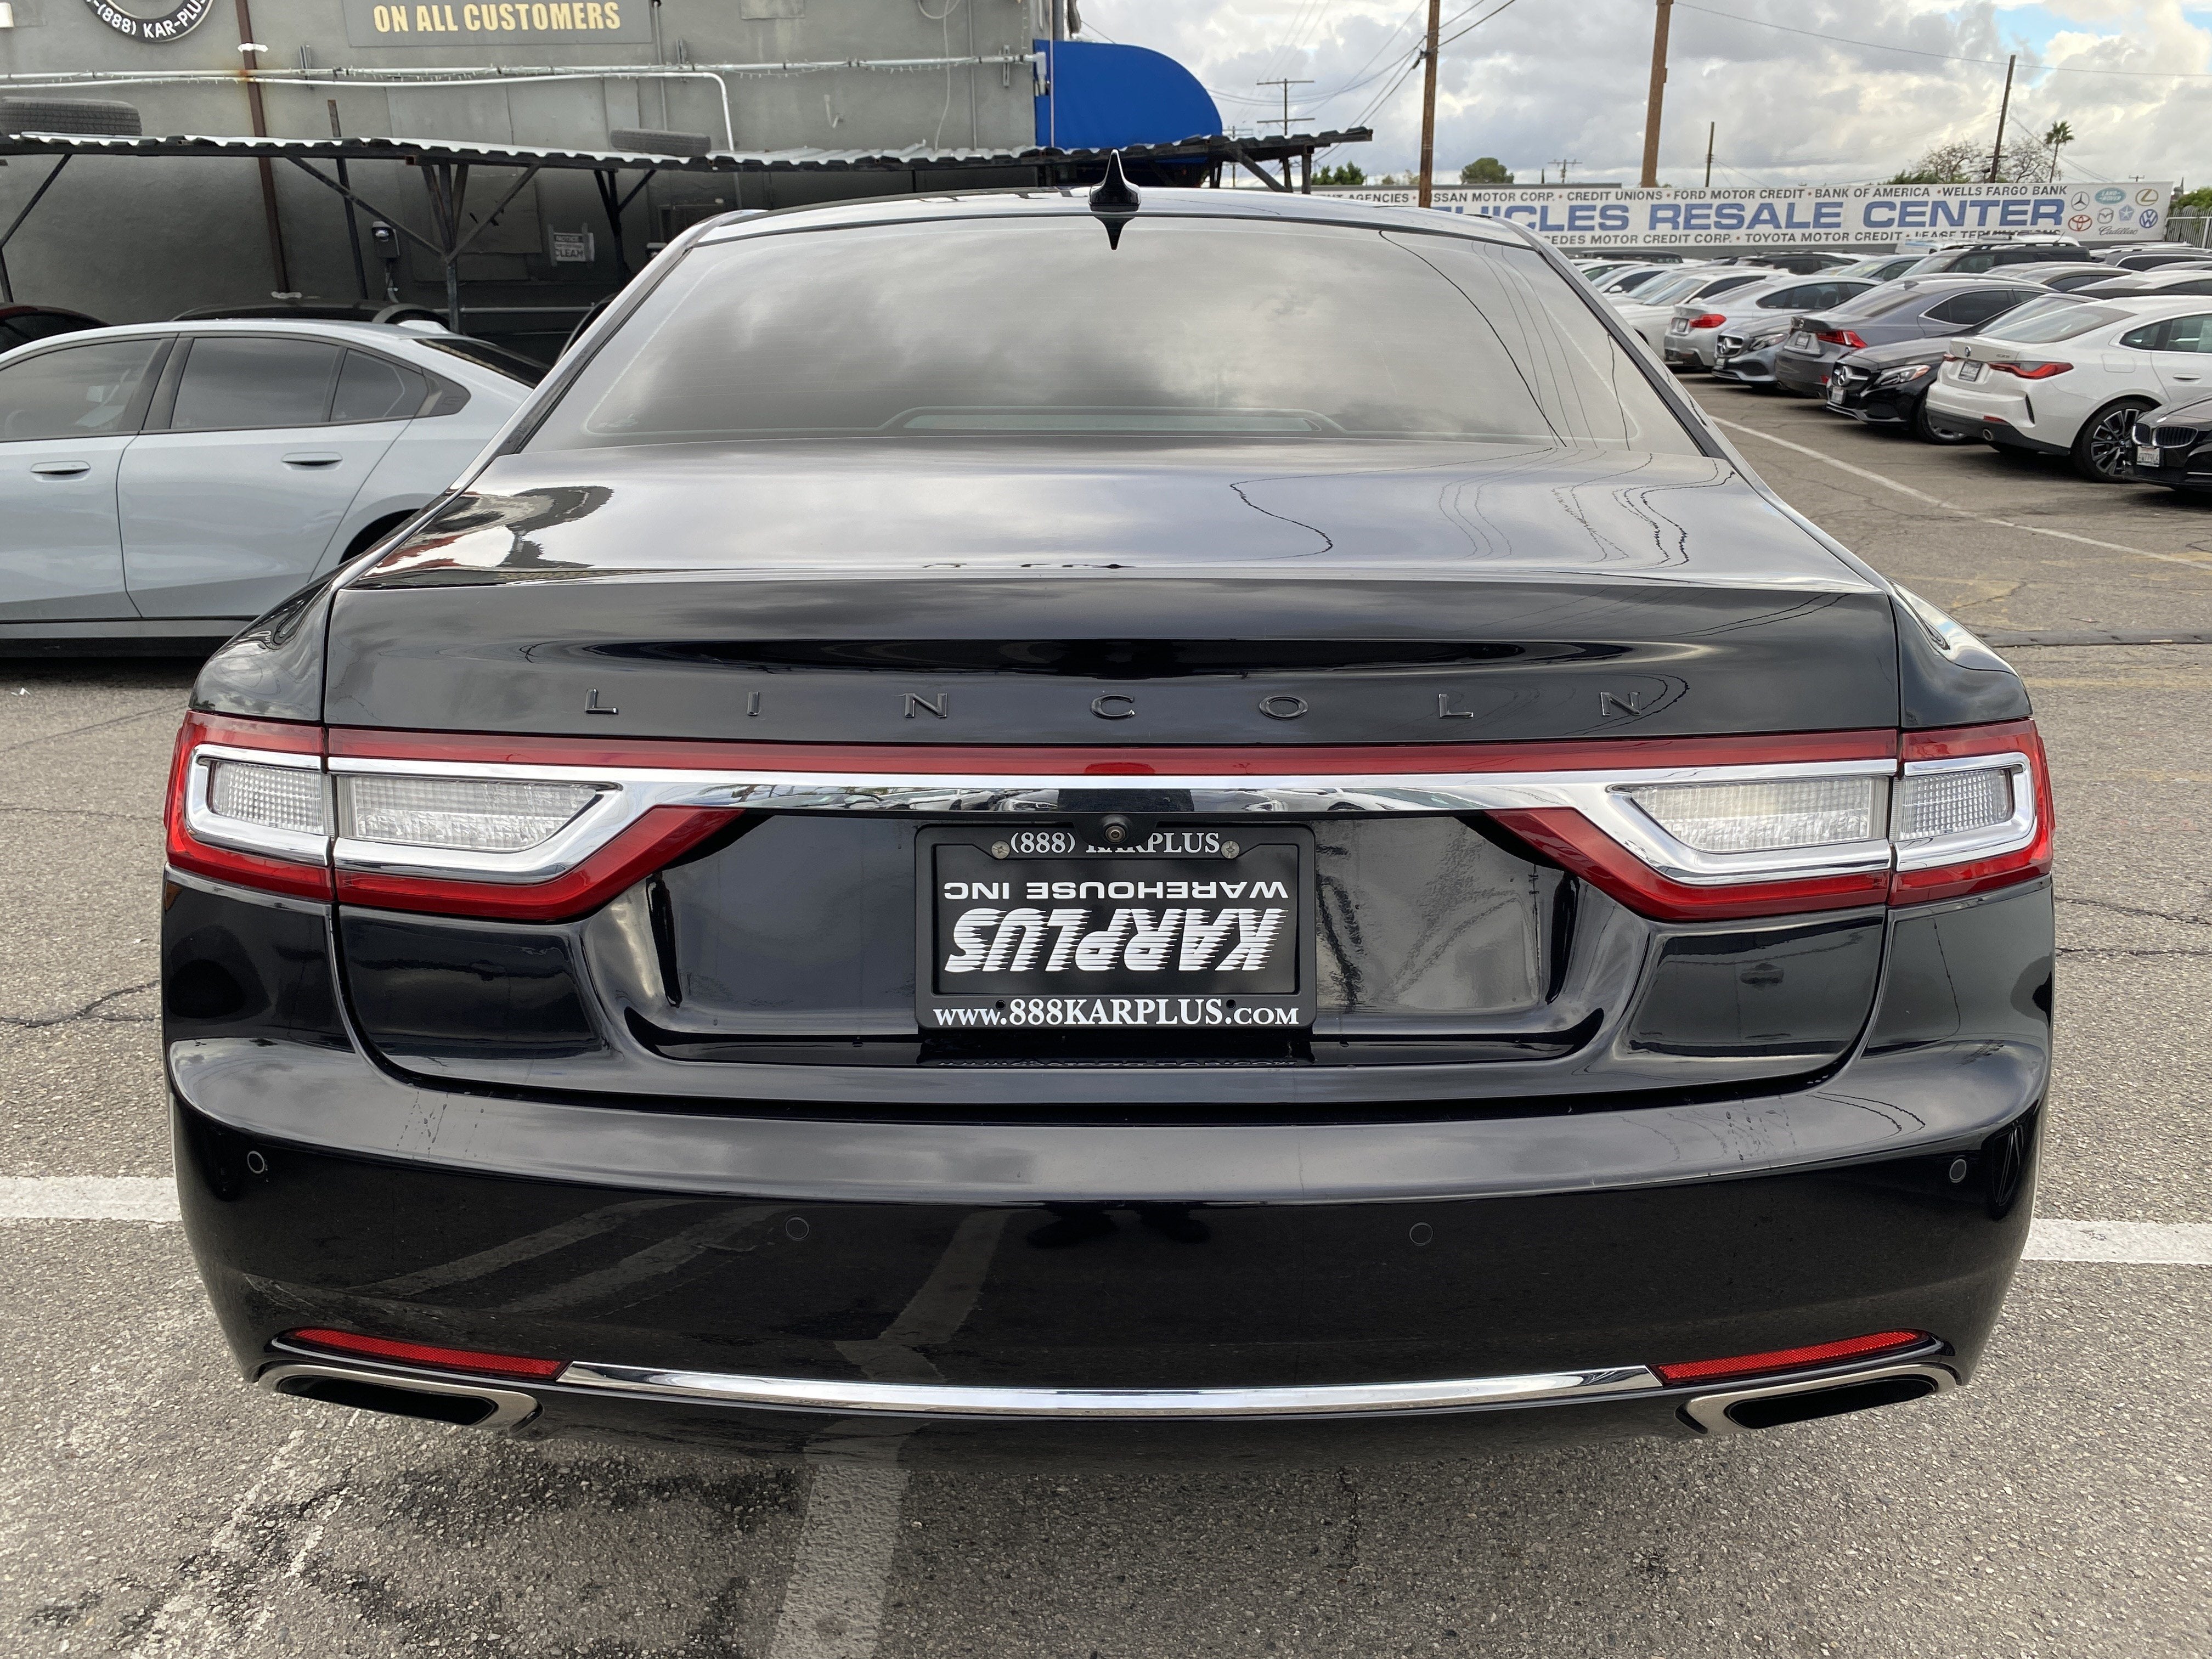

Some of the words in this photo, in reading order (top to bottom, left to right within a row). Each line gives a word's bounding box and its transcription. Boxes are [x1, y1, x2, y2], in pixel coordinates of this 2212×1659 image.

[374, 4, 409, 32] ON
[416, 4, 458, 32] ALL
[464, 1, 620, 31] CUSTOMERS
[1472, 192, 1516, 202] MOTOR
[1520, 191, 1555, 202] CORP.
[1567, 191, 1611, 201] CREDIT
[1615, 190, 1663, 201] UNIONS
[1673, 190, 1706, 200] FORD
[1710, 189, 1756, 200] MOTOR
[1759, 189, 1805, 199] CREDIT
[1815, 189, 1849, 199] BANK
[1854, 188, 1867, 198] OF
[1872, 187, 1931, 198] AMERICA
[1942, 187, 1982, 196] WELLS
[1986, 186, 2028, 196] FARGO
[2032, 185, 2068, 195] BANK
[1648, 201, 1844, 230] RESALE
[1863, 198, 2064, 228] CENTER
[1590, 234, 1639, 244] MOTOR
[1643, 234, 1691, 244] CREDIT
[1695, 233, 1732, 243] CORP.
[1745, 233, 1796, 243] TOYOTA
[1800, 232, 1850, 242] MOTOR
[1854, 231, 1903, 242] CREDIT
[2099, 225, 2138, 235] Cadillac
[585, 688, 1641, 720] LINCOLN
[1011, 831, 1076, 854] (888)
[944, 881, 1009, 900] INC
[1026, 881, 1289, 900] WAREHOUSE
[944, 907, 1289, 973] KARPLUS
